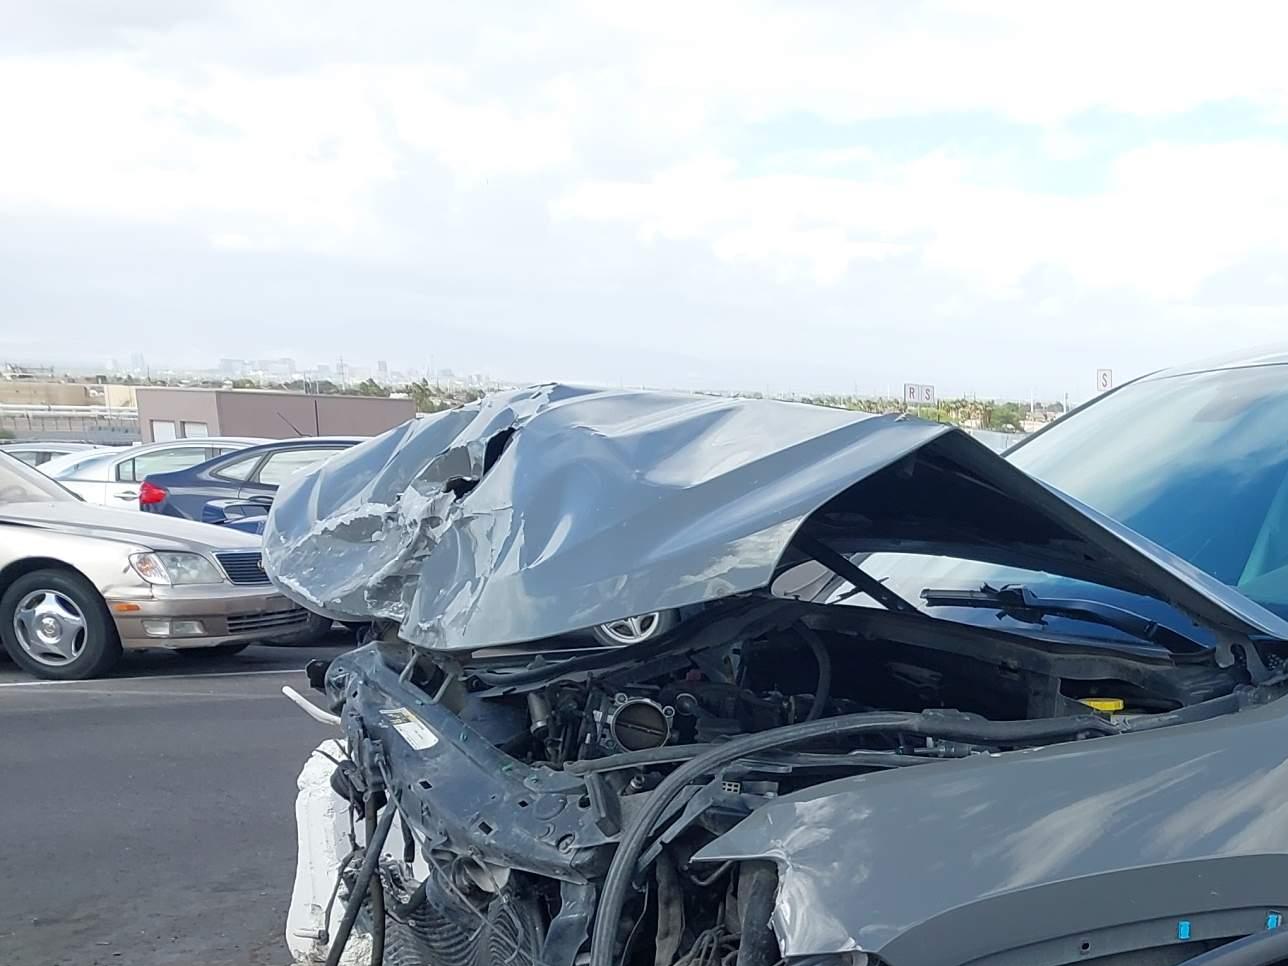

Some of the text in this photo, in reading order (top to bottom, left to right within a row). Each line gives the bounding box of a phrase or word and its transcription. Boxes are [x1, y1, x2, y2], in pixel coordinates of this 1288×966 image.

[1101, 373, 1108, 387] S
[908, 386, 916, 400] R
[924, 387, 931, 401] S
